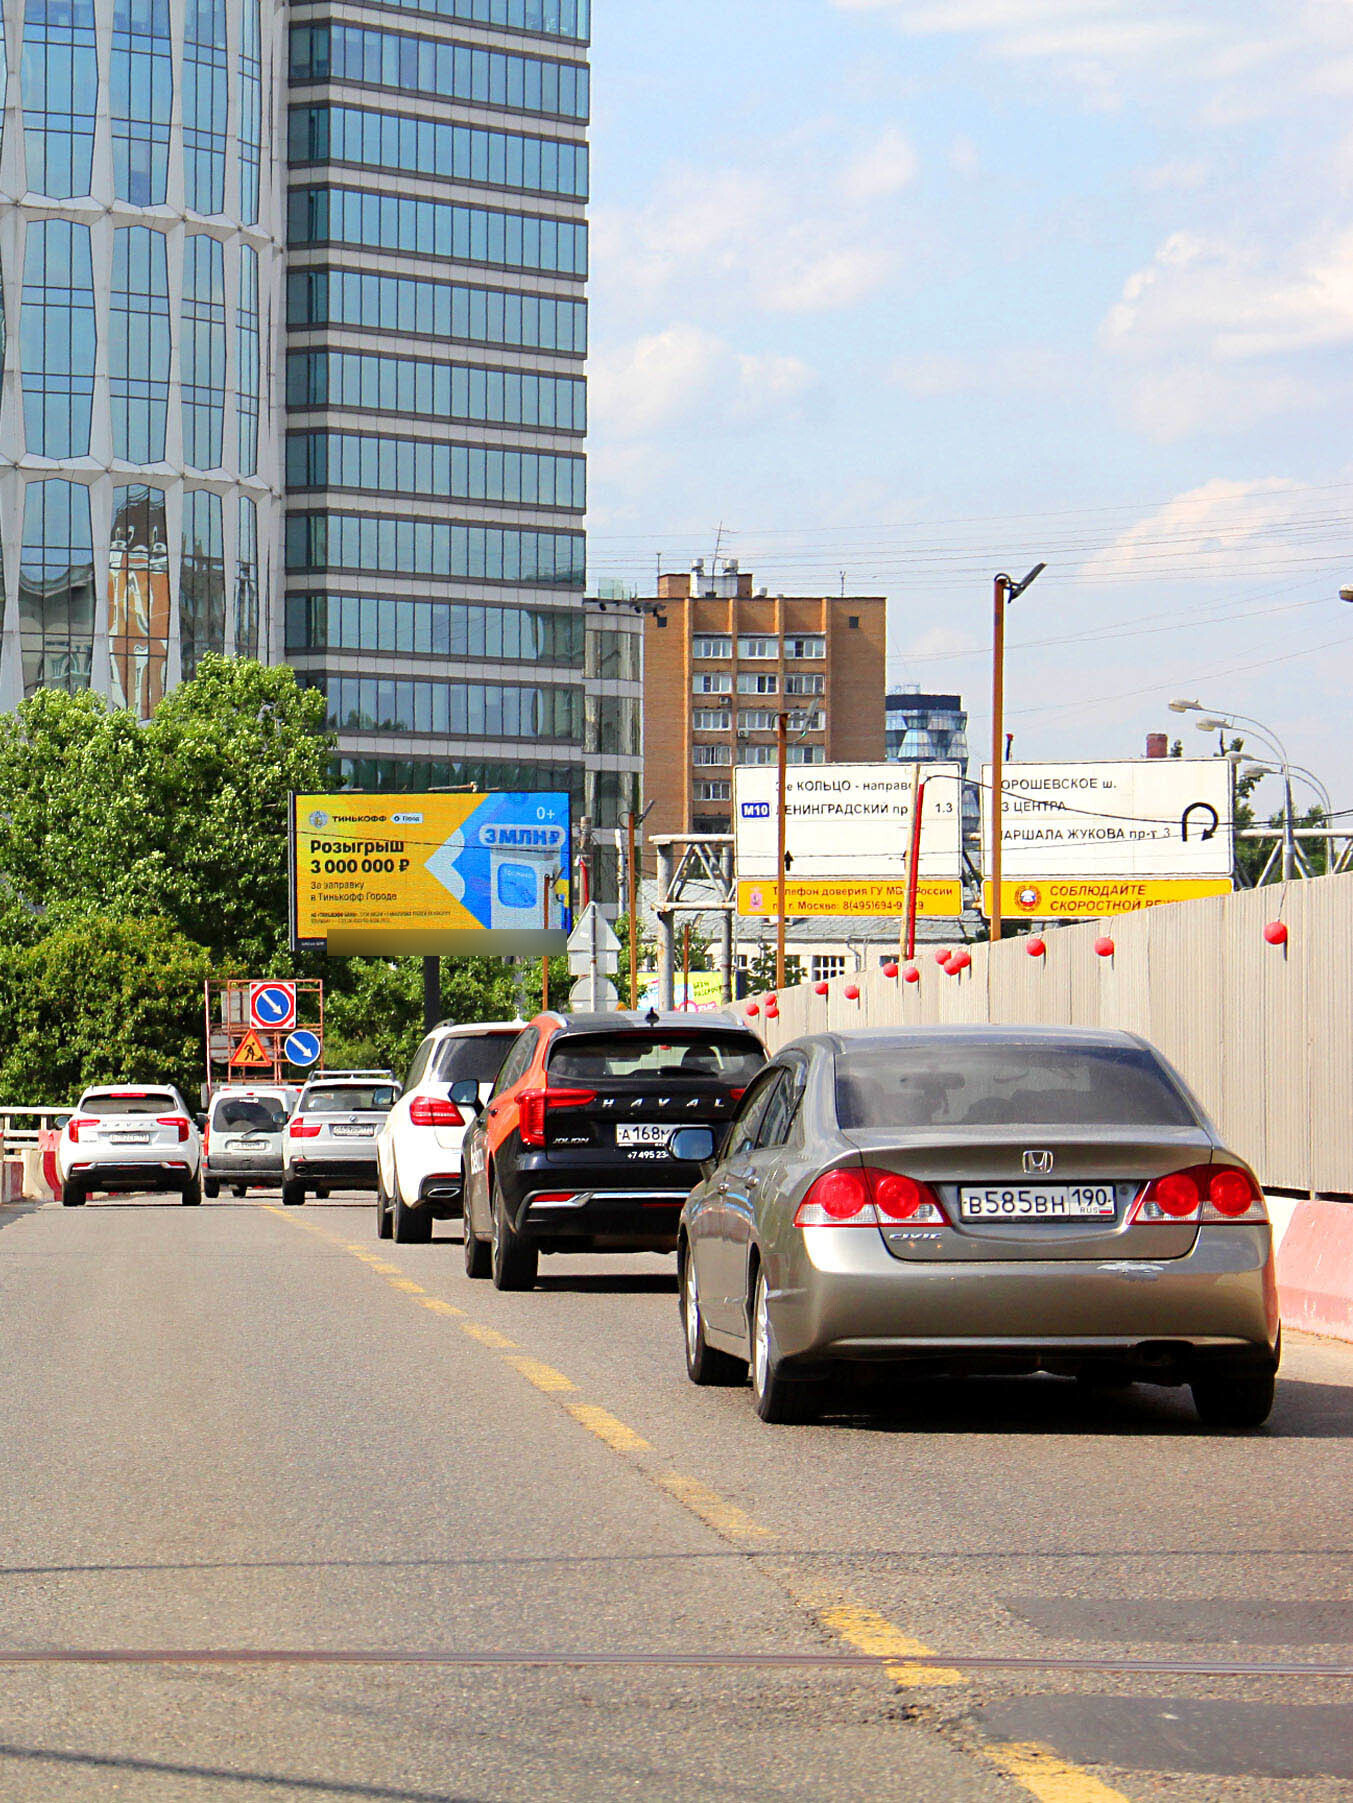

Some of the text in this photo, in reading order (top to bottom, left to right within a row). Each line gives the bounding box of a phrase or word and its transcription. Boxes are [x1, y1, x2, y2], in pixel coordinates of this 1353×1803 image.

[797, 780, 851, 792] КОЛЬЦО
[1001, 778, 1117, 790] ОРОШЕВСКОЕ ш.
[536, 806, 555, 819] 0+
[743, 804, 769, 816] М10
[776, 802, 888, 815] ЕНИНГРАДСКИЙ
[935, 802, 953, 813] 1.3
[1014, 801, 1066, 814] ЦЕНТРА
[332, 815, 387, 823] ТИНЬКОФФ
[484, 828, 496, 843] 3
[499, 829, 547, 845] МЛН
[1001, 829, 1063, 840] АРШАЛА
[1067, 828, 1125, 839] ЖУКОВА
[311, 840, 404, 856] Розыгрыш
[310, 860, 321, 874] 3
[324, 860, 357, 874] 000
[361, 859, 395, 873] 000
[311, 881, 365, 891] За заправку
[772, 886, 819, 897] Тлефон
[822, 888, 867, 897] доверия
[871, 886, 883, 895] ГУ
[886, 886, 904, 895] МВ
[1050, 884, 1147, 898] СОБЛЮДАЙТЕ
[319, 892, 364, 902] Тинькофф
[366, 892, 397, 902] Городе
[1050, 899, 1141, 911] СКОРОСТНОЙ
[602, 1098, 725, 1108] HAVAL
[639, 1150, 655, 1159] 495
[969, 1188, 1108, 1214] В585ВН 190
[1079, 1206, 1098, 1214] RUS
[888, 1232, 943, 1241] CIVIC
